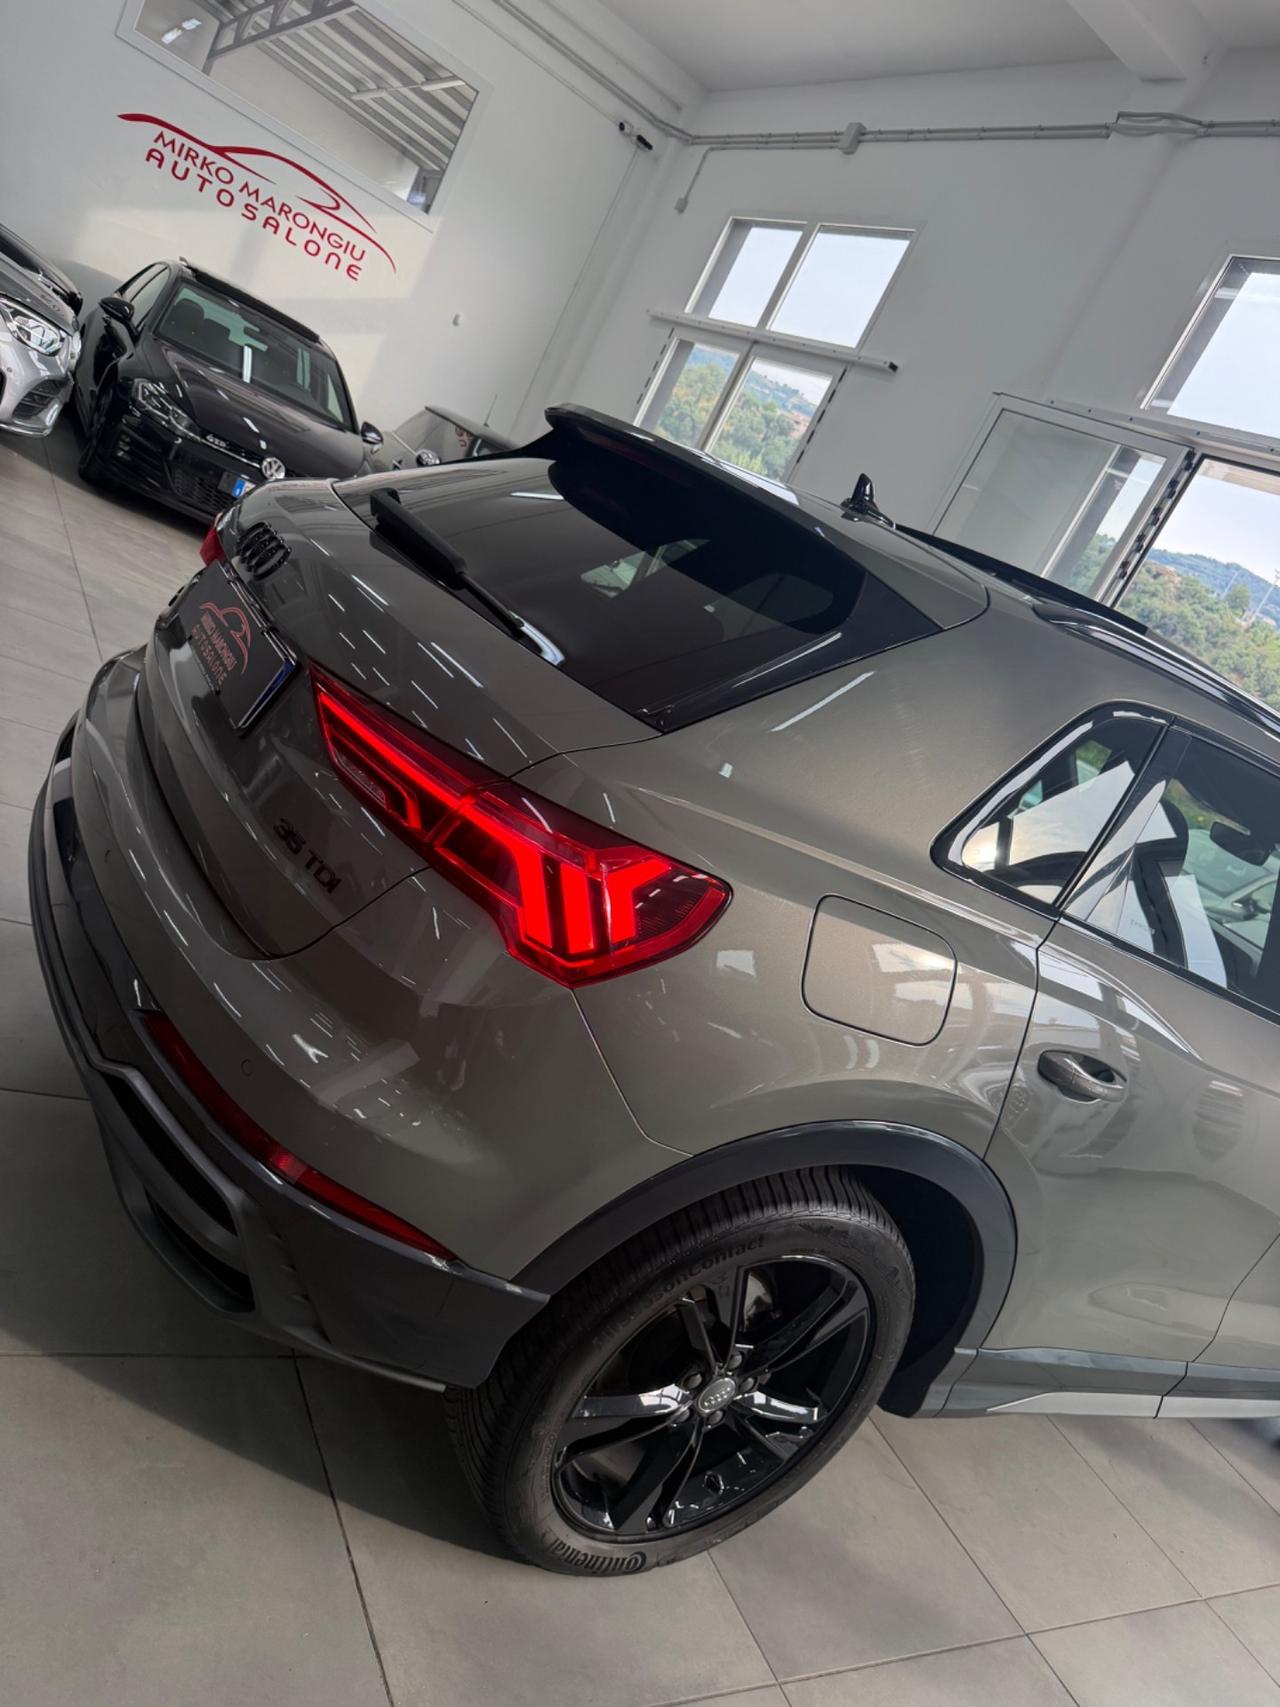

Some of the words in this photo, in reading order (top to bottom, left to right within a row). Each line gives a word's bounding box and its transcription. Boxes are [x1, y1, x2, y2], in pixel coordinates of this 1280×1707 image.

[154, 131, 235, 185] MIRKO
[239, 182, 366, 262] MARONGIU
[305, 849, 343, 894] TDI
[548, 1537, 647, 1574] Continental
